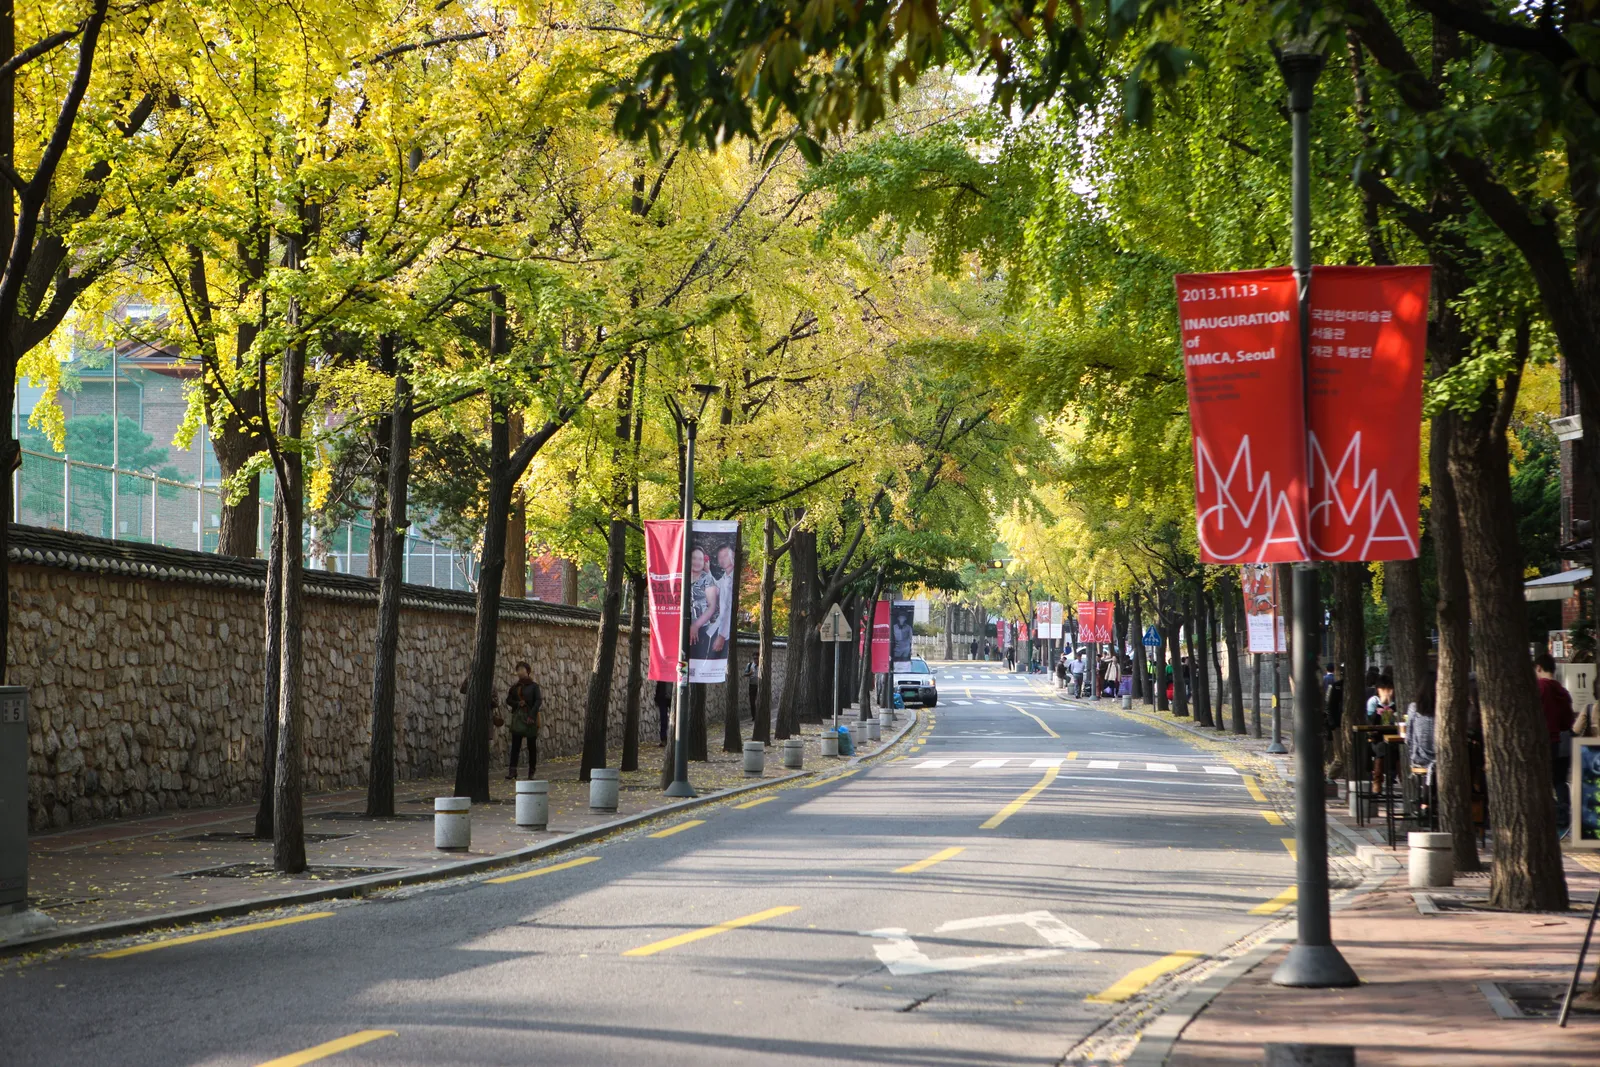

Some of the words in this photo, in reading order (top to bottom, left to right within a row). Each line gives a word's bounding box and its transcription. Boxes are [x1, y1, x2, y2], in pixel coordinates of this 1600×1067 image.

[1184, 310, 1290, 331] INAUGURATION
[1311, 308, 1392, 323] 국립현대미술관
[1311, 327, 1346, 340] 서울관
[1185, 335, 1201, 349] of
[1187, 351, 1235, 367] MMCA,
[1236, 347, 1276, 362] Seoul
[1310, 345, 1334, 358] 개관
[1336, 345, 1373, 359] 특별전
